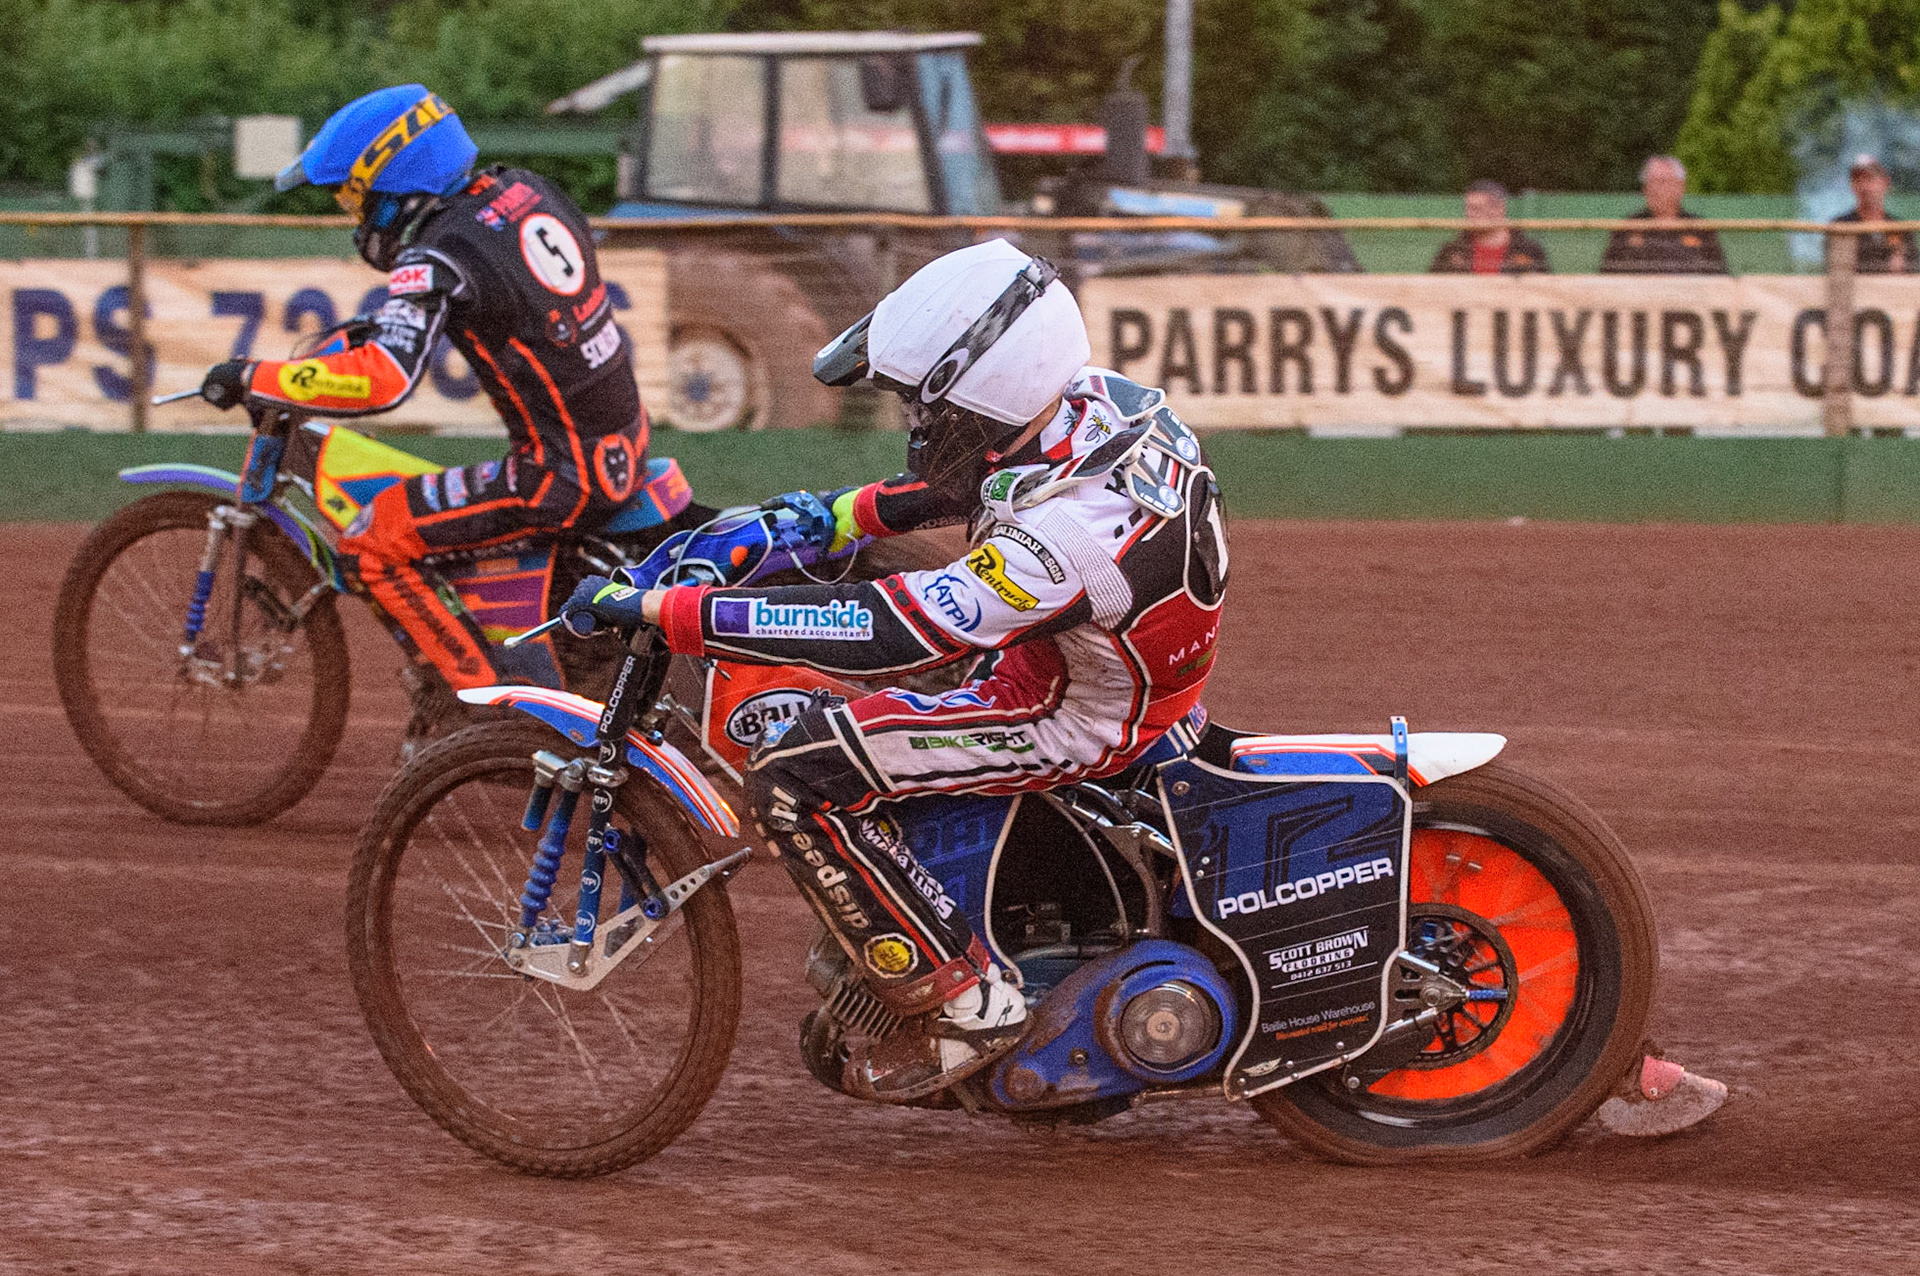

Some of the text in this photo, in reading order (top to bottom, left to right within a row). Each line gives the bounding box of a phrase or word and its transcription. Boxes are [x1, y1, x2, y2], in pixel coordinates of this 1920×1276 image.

[535, 227, 575, 277] 5
[1110, 307, 1415, 396] PARRYS
[1450, 308, 1758, 398] LUXURY
[967, 548, 1031, 609] Rentruck
[756, 601, 870, 629] burnside
[935, 585, 971, 627] ATPI
[756, 628, 871, 638] chartered accountants
[600, 654, 637, 734] POLCOPPER
[907, 867, 957, 920] SCOTT
[1217, 857, 1395, 920] POLCOPPER
[1268, 929, 1370, 971] SCOTT BROWN
[1284, 948, 1352, 973] FLOORING
[1289, 1013, 1321, 1028] House
[1321, 1001, 1376, 1020] Warehouse
